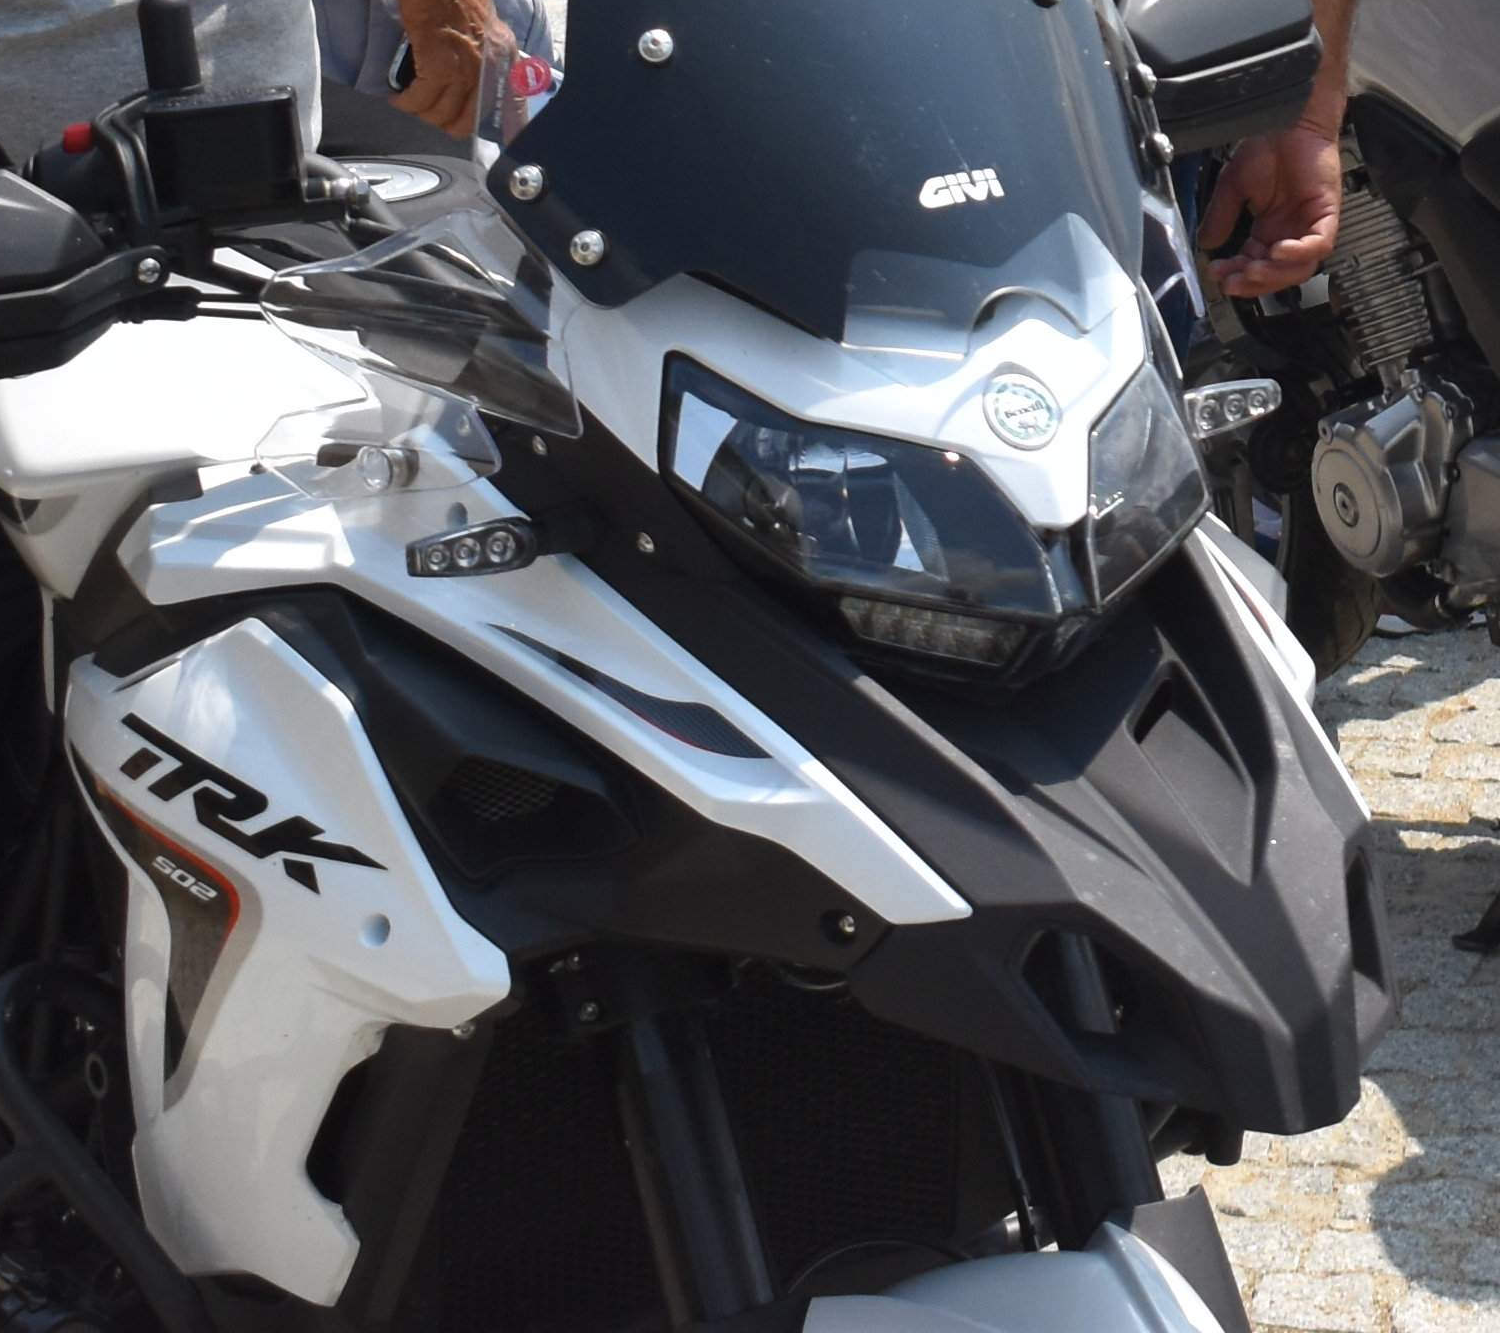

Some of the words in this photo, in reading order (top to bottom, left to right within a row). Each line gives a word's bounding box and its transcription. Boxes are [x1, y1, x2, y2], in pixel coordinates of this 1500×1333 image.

[918, 167, 1005, 210] GIVI
[1003, 400, 1044, 419] Benelli
[119, 712, 389, 895] TRK
[152, 854, 218, 902] 502
